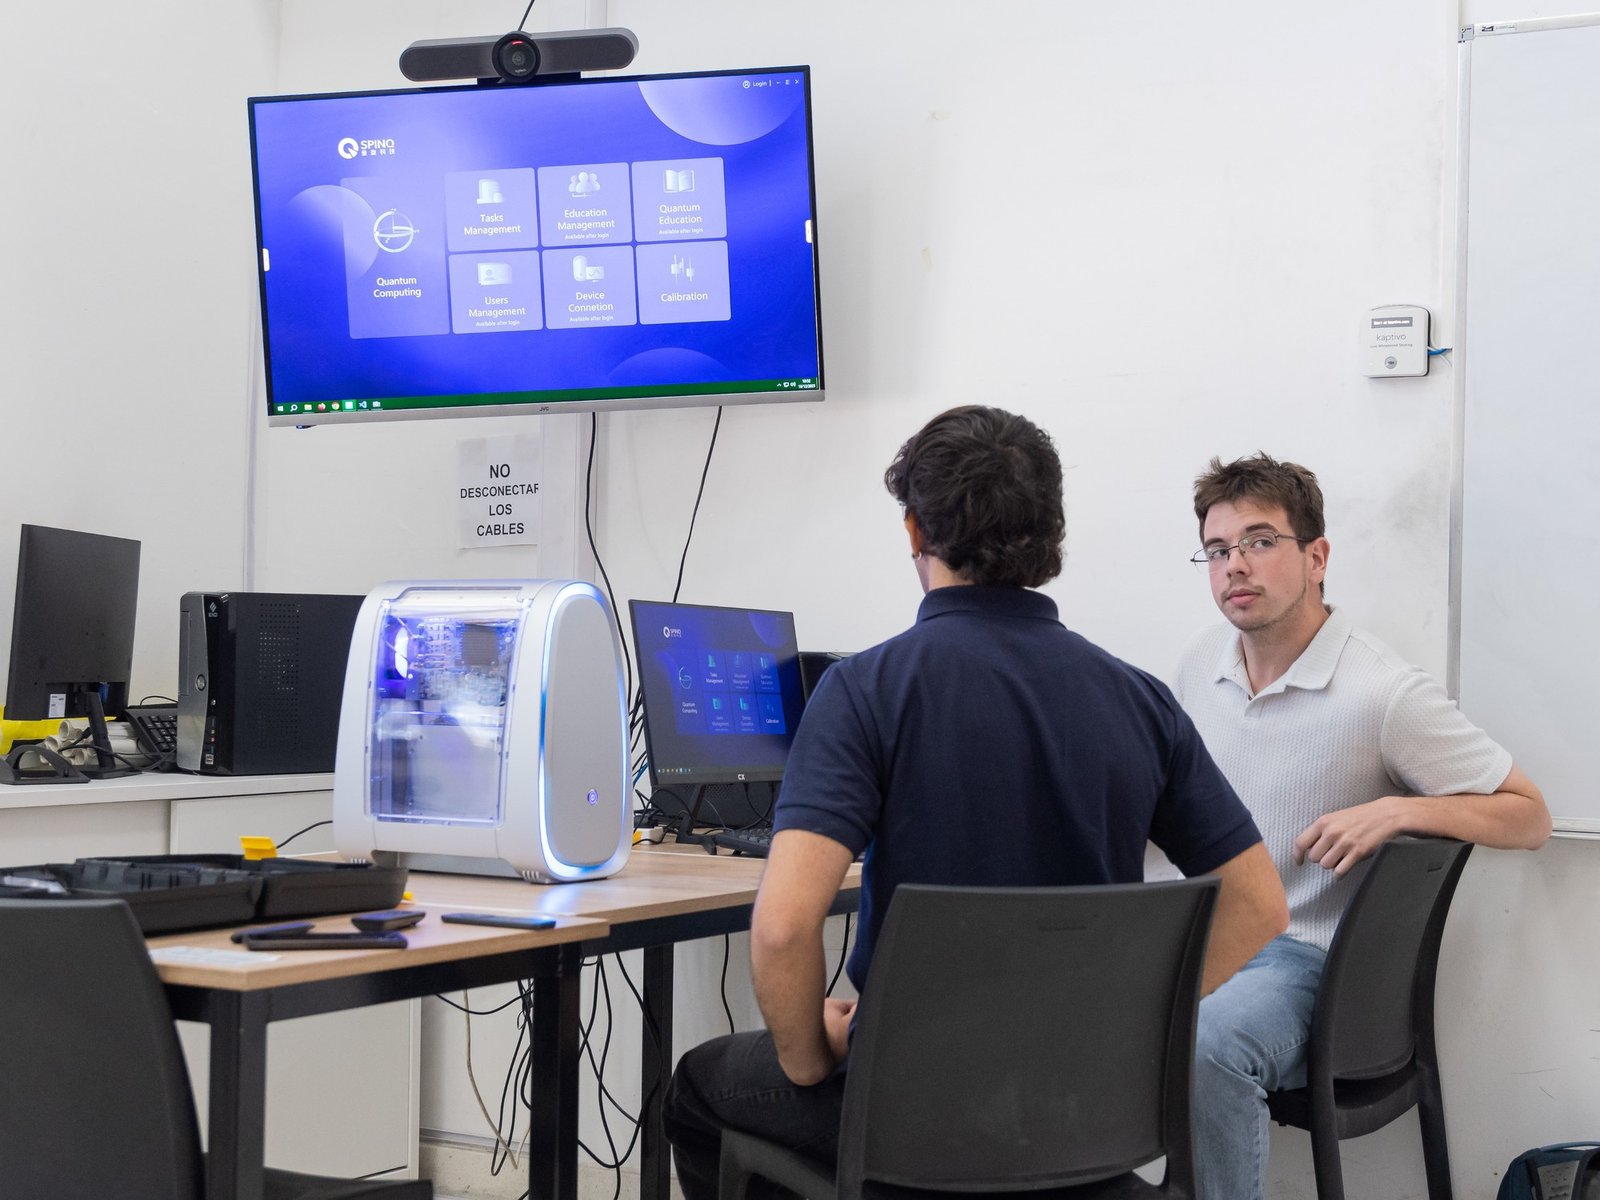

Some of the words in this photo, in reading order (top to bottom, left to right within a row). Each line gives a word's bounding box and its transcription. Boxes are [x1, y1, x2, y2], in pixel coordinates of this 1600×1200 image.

[752, 80, 768, 88] Login
[563, 208, 608, 220] Education
[659, 203, 701, 215] Quantum
[480, 213, 504, 224] Tasks
[659, 214, 703, 226] Education
[464, 224, 522, 237] Management
[557, 219, 616, 232] Management
[376, 276, 418, 287] Quantum
[373, 287, 422, 299] Computing
[575, 291, 605, 301] Device
[660, 291, 709, 303] Calibration
[484, 296, 509, 306] Users
[468, 306, 527, 319] Management
[568, 302, 614, 313] Connetion
[1376, 333, 1407, 343] kaptivo
[489, 463, 511, 479] NO
[489, 503, 513, 516] LOS
[476, 522, 525, 537] CABLES
